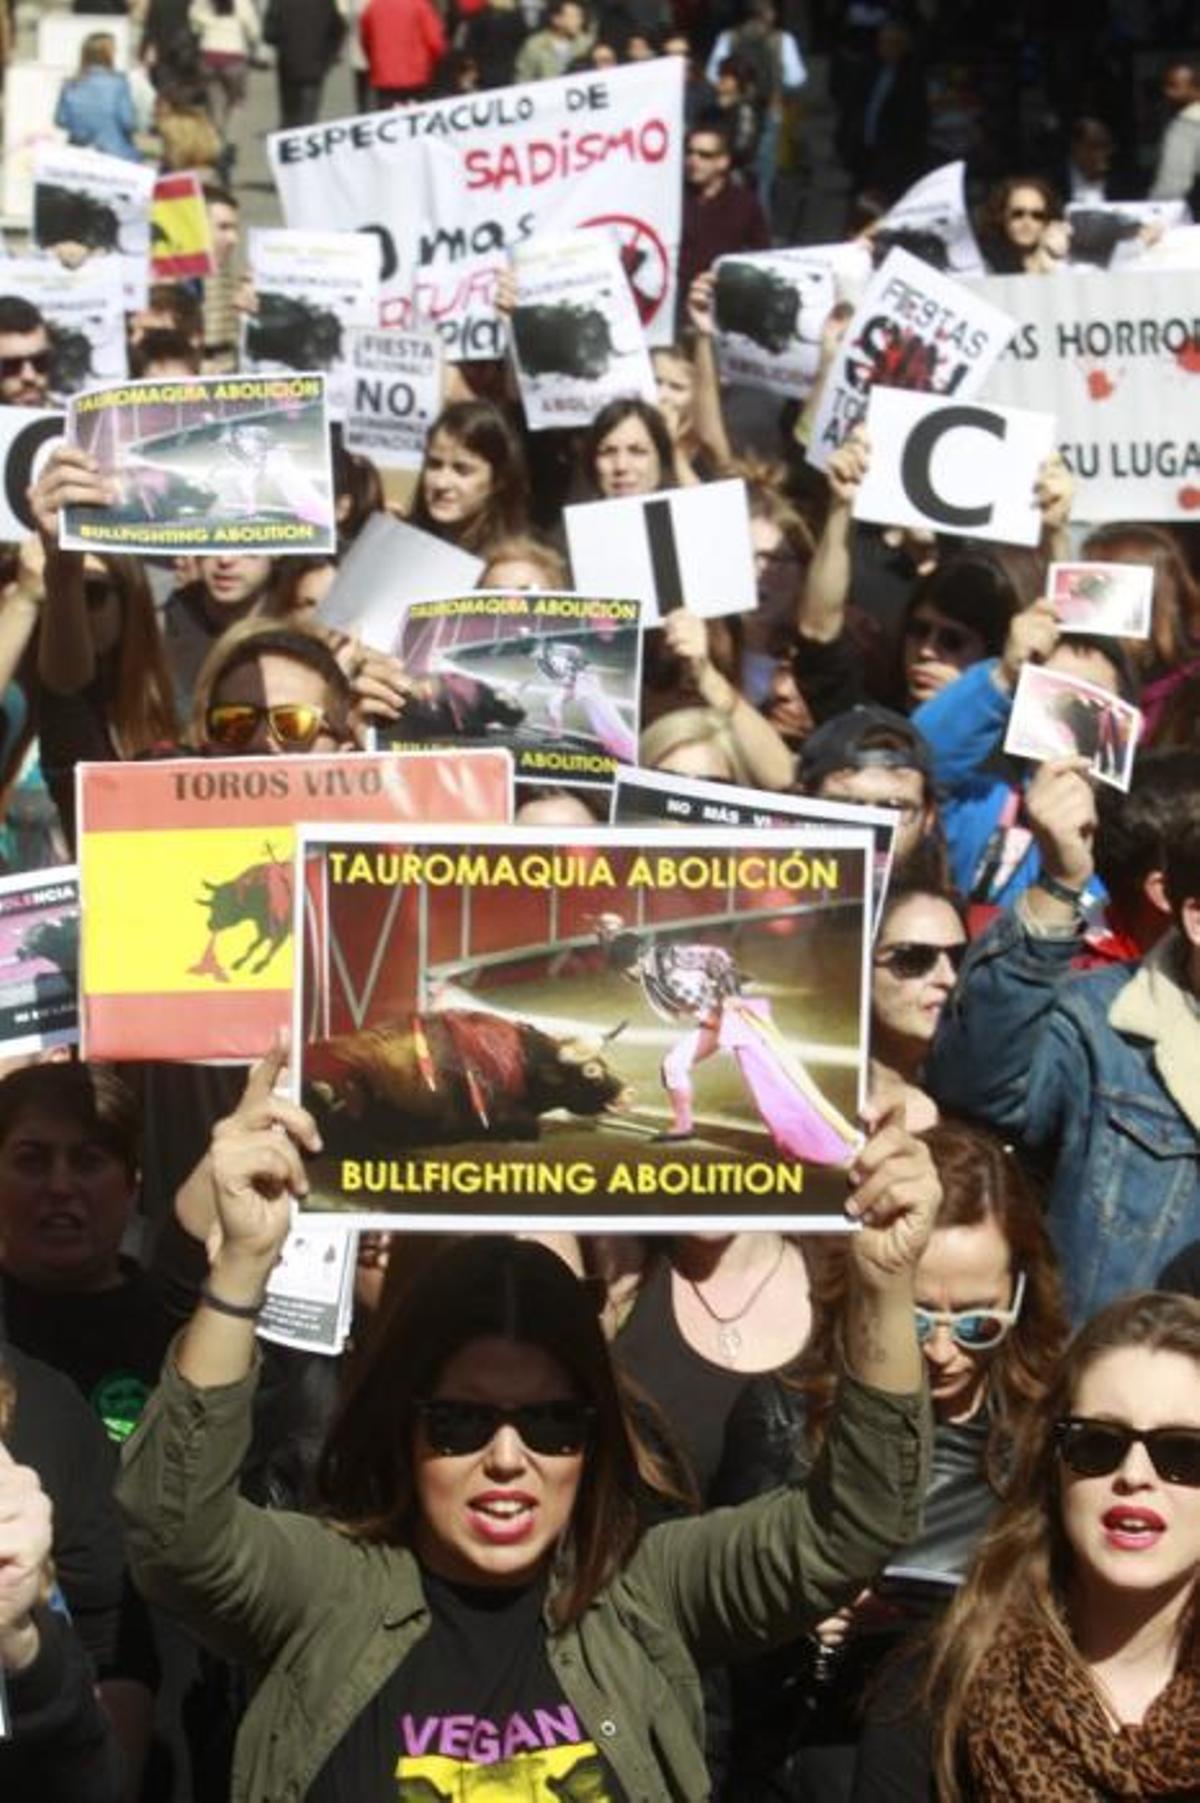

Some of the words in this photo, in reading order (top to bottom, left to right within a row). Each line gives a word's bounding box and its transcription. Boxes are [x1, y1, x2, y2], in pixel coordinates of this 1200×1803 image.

[279, 97, 534, 164] ESPECTACULO
[566, 83, 610, 113] DE
[78, 384, 207, 412] TAUROMAQUIA
[356, 378, 427, 417] NO.
[902, 406, 1007, 527] C
[80, 524, 209, 543] BULLFIGHTING
[213, 524, 314, 542] ABOLITION
[411, 599, 528, 618] TAUROMAQUIA
[520, 751, 619, 773] ABOLITION
[173, 770, 289, 801] TOROS
[666, 798, 692, 815] NO
[329, 852, 615, 889] TAUROMAQUIA
[628, 850, 838, 889] ABOLICIÓN
[342, 1159, 596, 1194] BULLFIGHTING
[608, 1162, 803, 1195] ABOLITION
[402, 1704, 581, 1765] VEGAN
